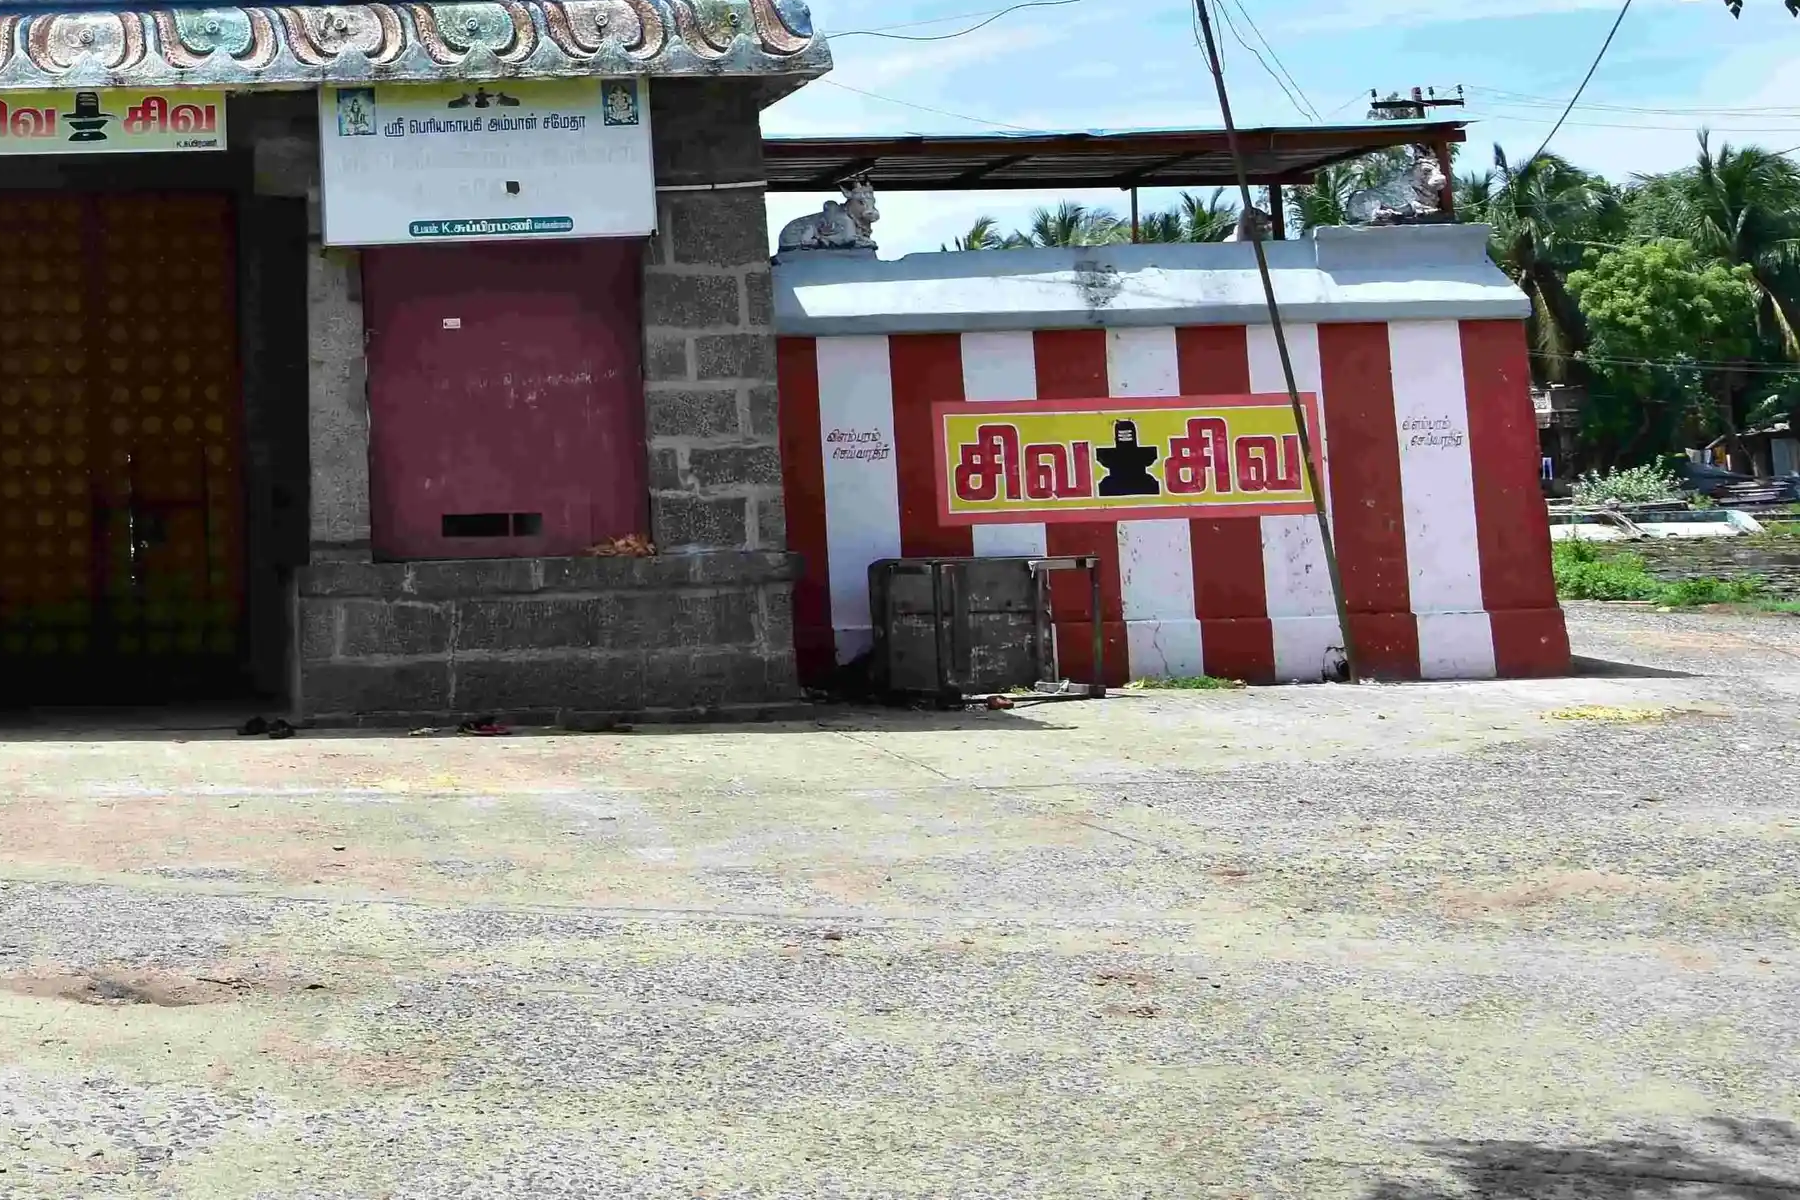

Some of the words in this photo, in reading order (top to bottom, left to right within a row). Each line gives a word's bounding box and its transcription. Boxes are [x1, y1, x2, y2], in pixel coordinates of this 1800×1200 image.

[123, 96, 217, 135] சிவ
[384, 117, 405, 137] ஸ்ரீ
[409, 116, 483, 134] பெரியநாயகி
[487, 113, 538, 132] அம்பாள்
[543, 113, 586, 131] சமேதா
[442, 219, 533, 234] K.சுப்பிரமணி
[954, 424, 1093, 500] சிவ
[1163, 417, 1303, 494] சிவ
